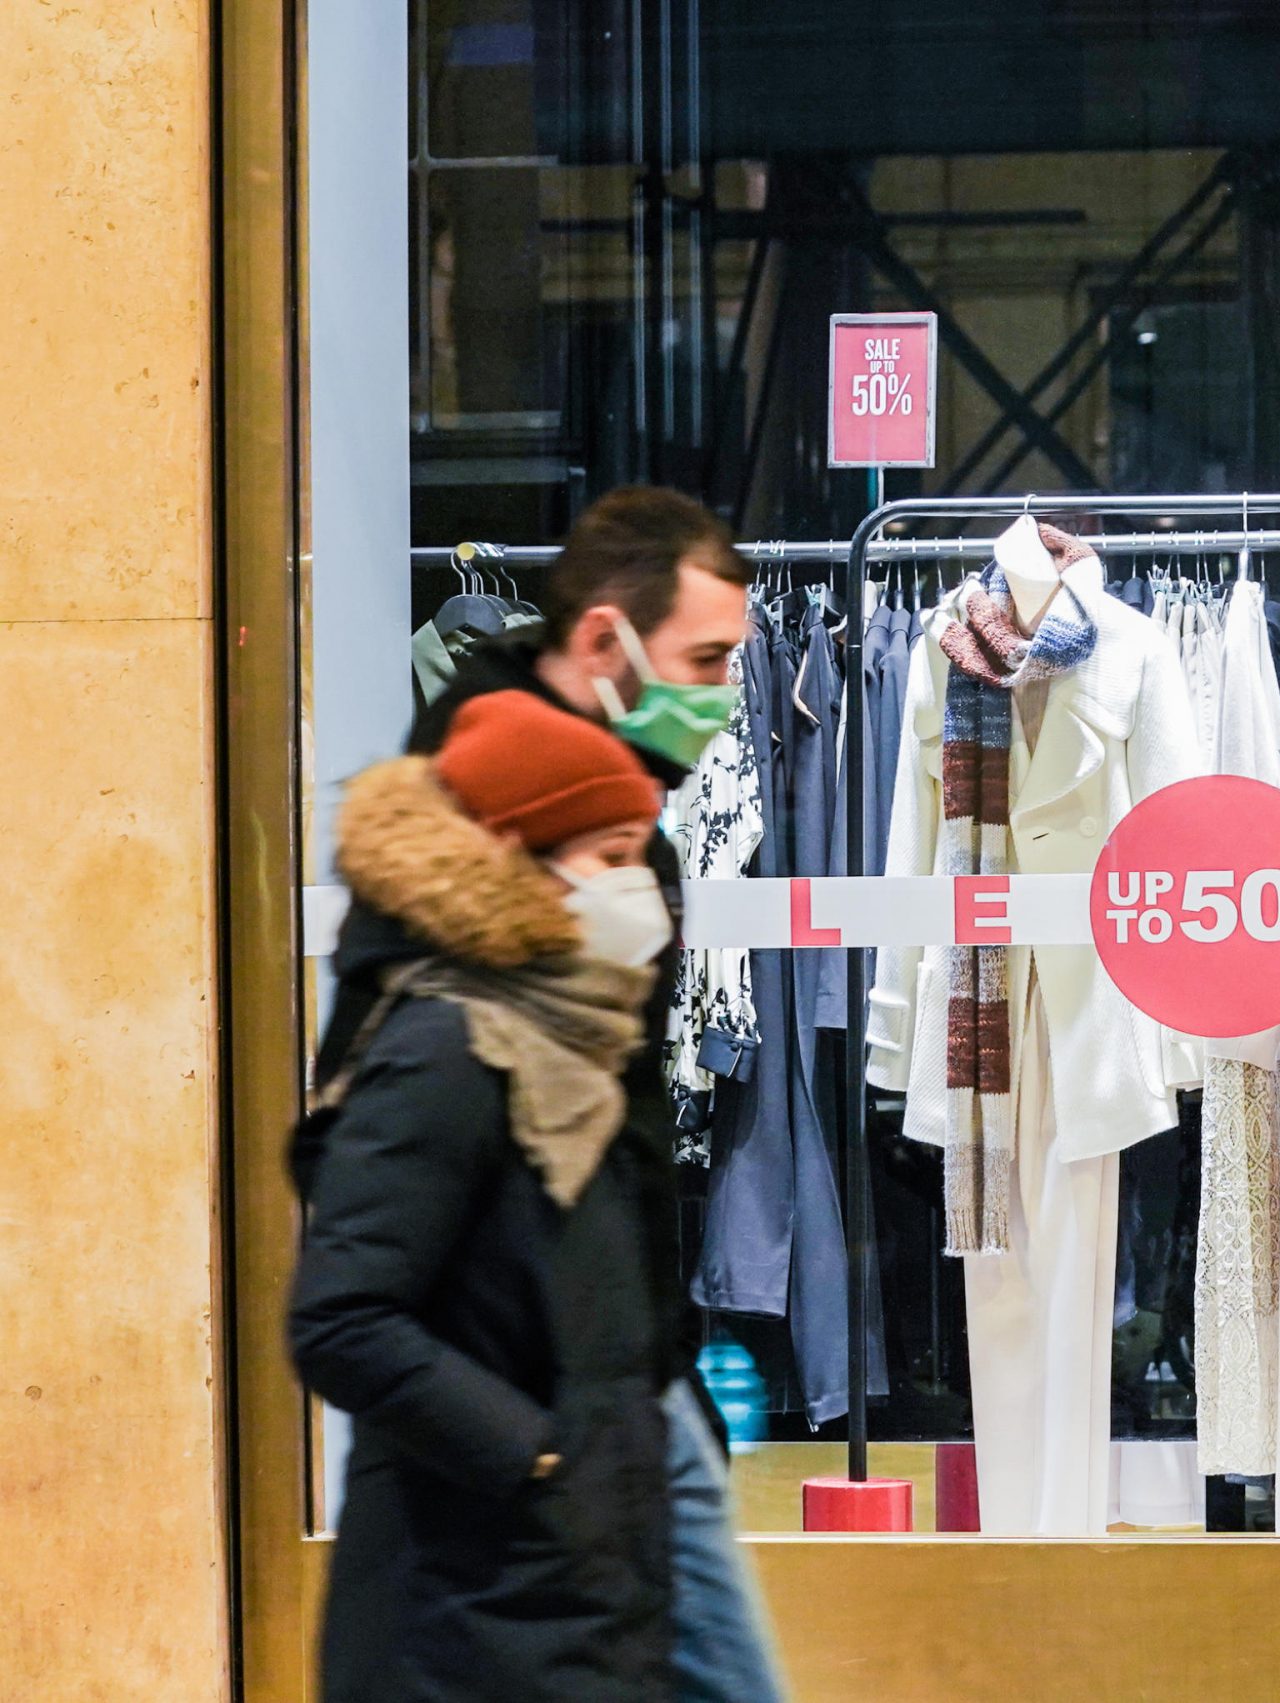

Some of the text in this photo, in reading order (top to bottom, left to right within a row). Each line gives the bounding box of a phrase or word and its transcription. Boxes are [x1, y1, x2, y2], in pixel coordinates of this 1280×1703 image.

[864, 338, 901, 361] SALE
[869, 360, 895, 374] UP TO
[851, 373, 913, 416] 50%
[1107, 870, 1174, 906] UP
[1105, 908, 1174, 944] TO
